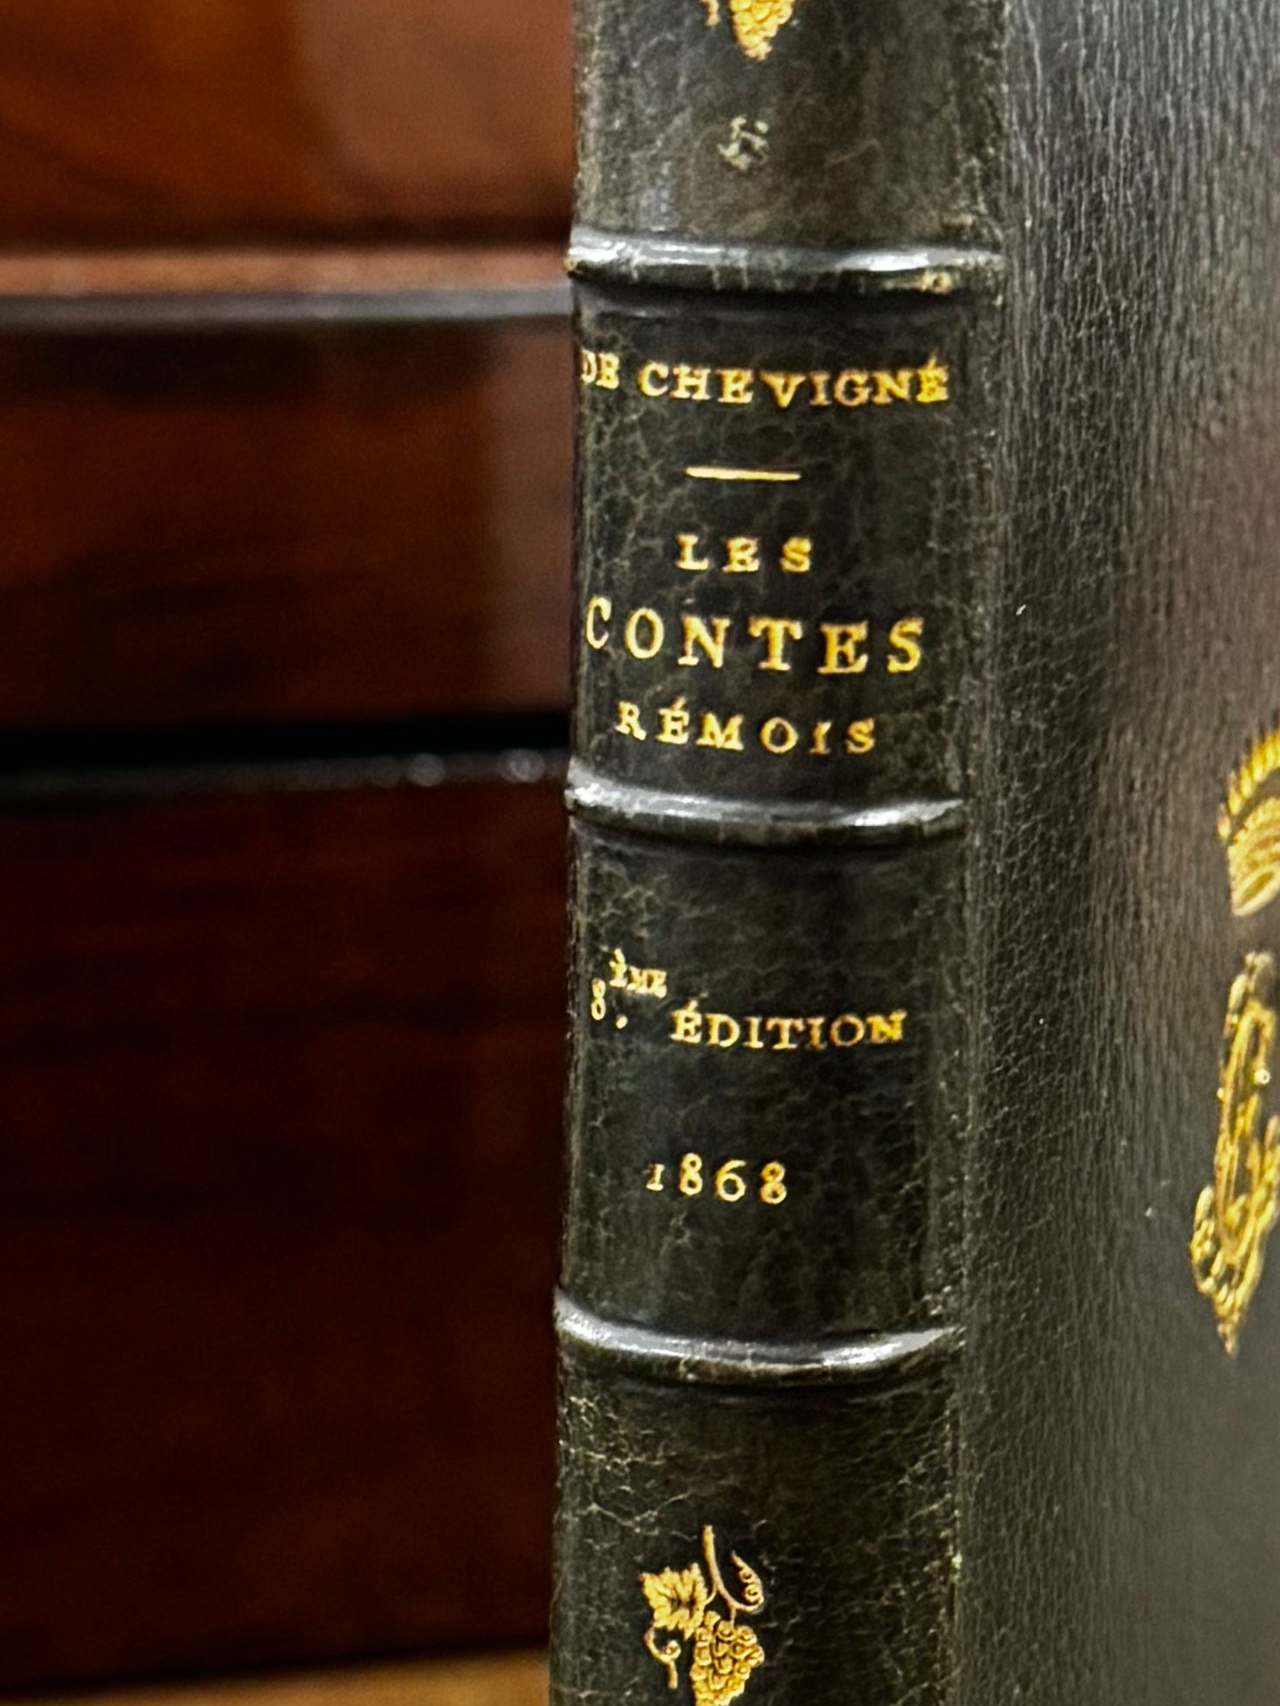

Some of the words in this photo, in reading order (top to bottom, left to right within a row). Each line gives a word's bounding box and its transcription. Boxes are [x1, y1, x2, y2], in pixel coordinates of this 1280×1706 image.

[637, 354, 950, 408] CHEVIGNÉ
[675, 533, 813, 574] LES
[585, 596, 924, 675] CONTES
[614, 697, 876, 756] RÉMOIS
[670, 999, 907, 1050] ÉDITION
[646, 1153, 788, 1205] 1868
